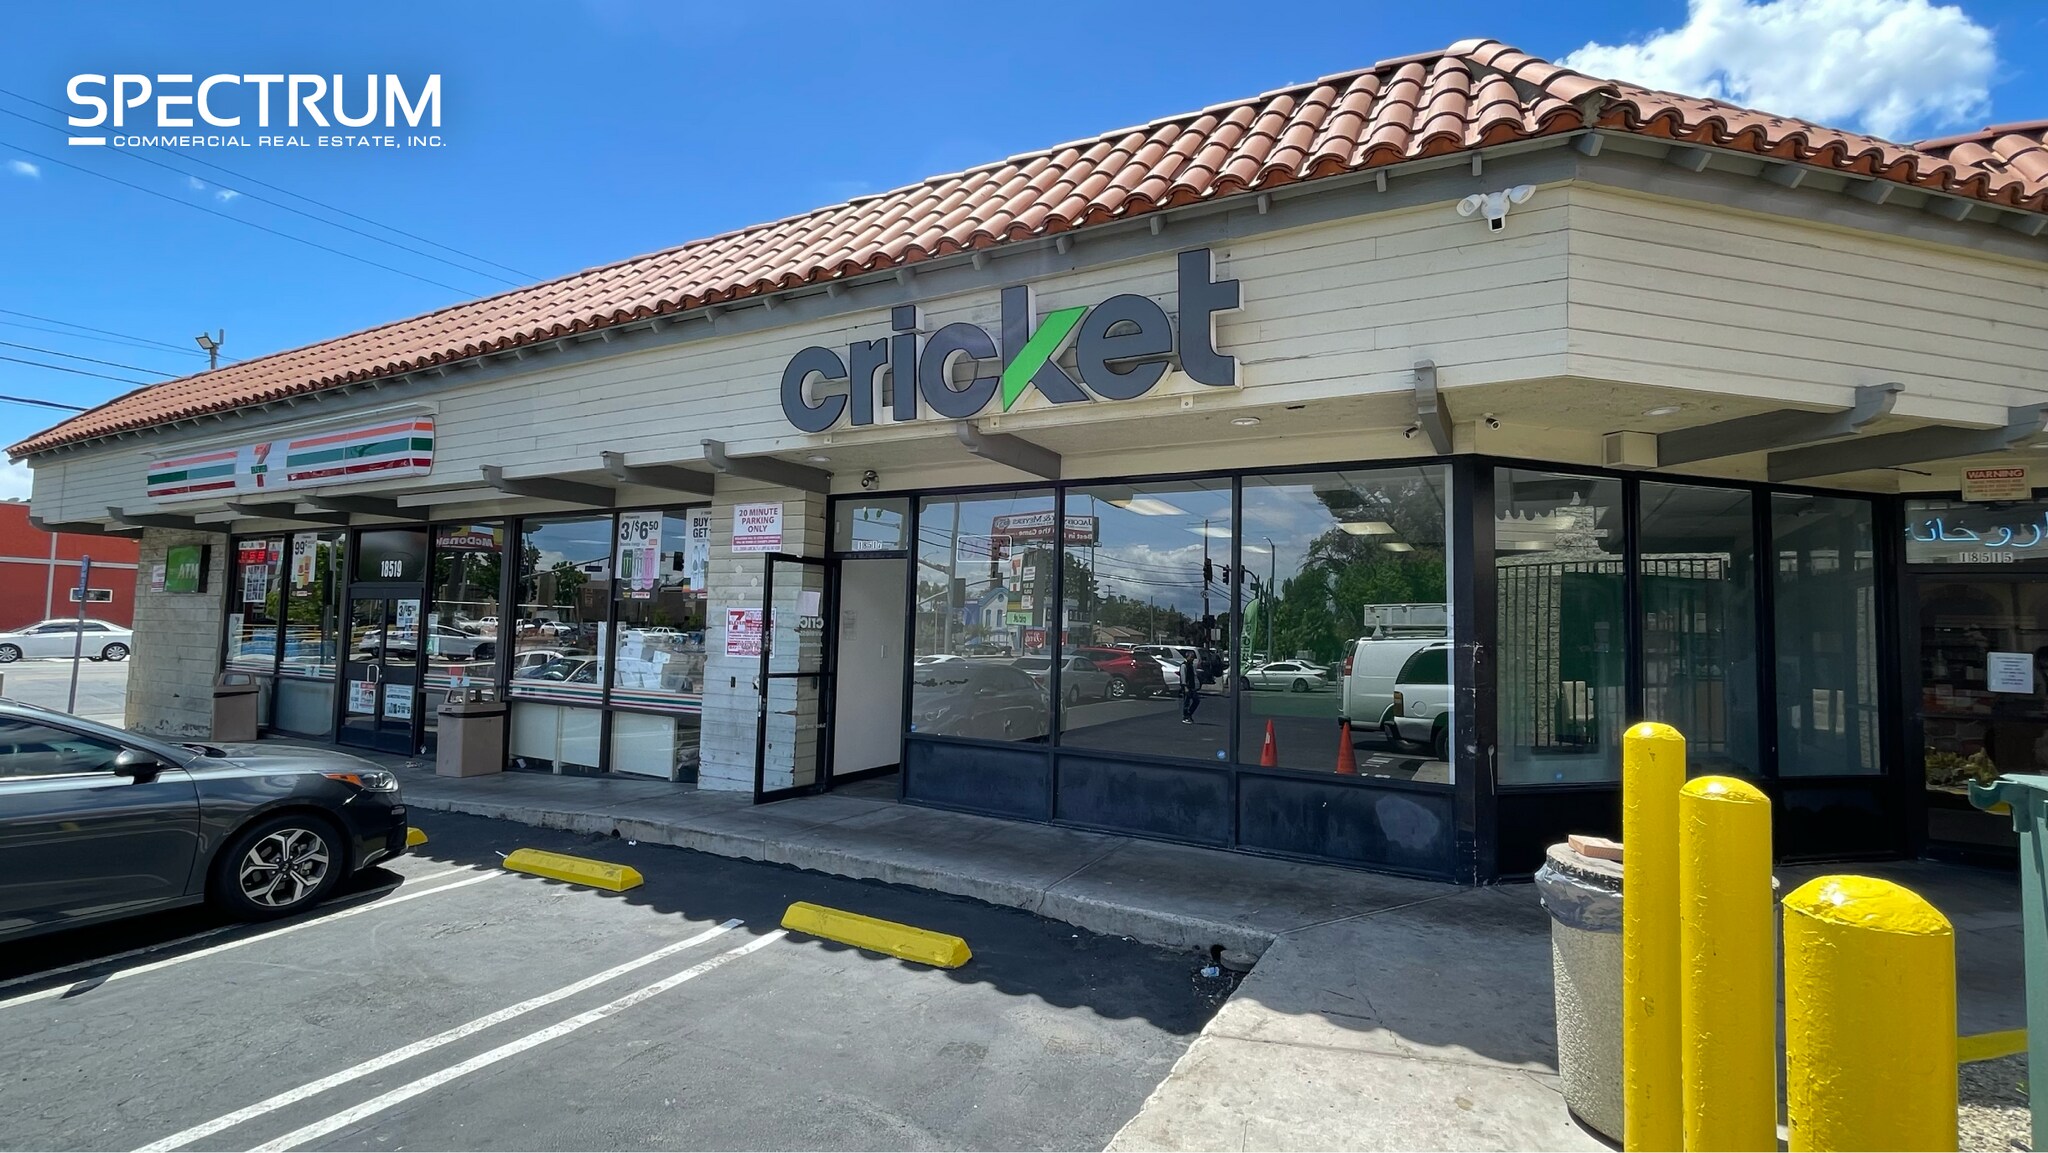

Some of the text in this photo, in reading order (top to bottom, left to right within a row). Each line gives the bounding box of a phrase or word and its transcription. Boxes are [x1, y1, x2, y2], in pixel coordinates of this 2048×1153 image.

[780, 247, 1242, 433] cricket
[1967, 469, 2023, 479] WARNING
[739, 507, 778, 517] 20 MINUTE
[693, 517, 709, 527] BUY
[741, 516, 775, 525] PARKING
[692, 528, 708, 538] GET
[747, 525, 768, 533] ONLY
[1961, 552, 2014, 563] 18515
[178, 563, 200, 579] ATM
[381, 560, 402, 578] 18519
